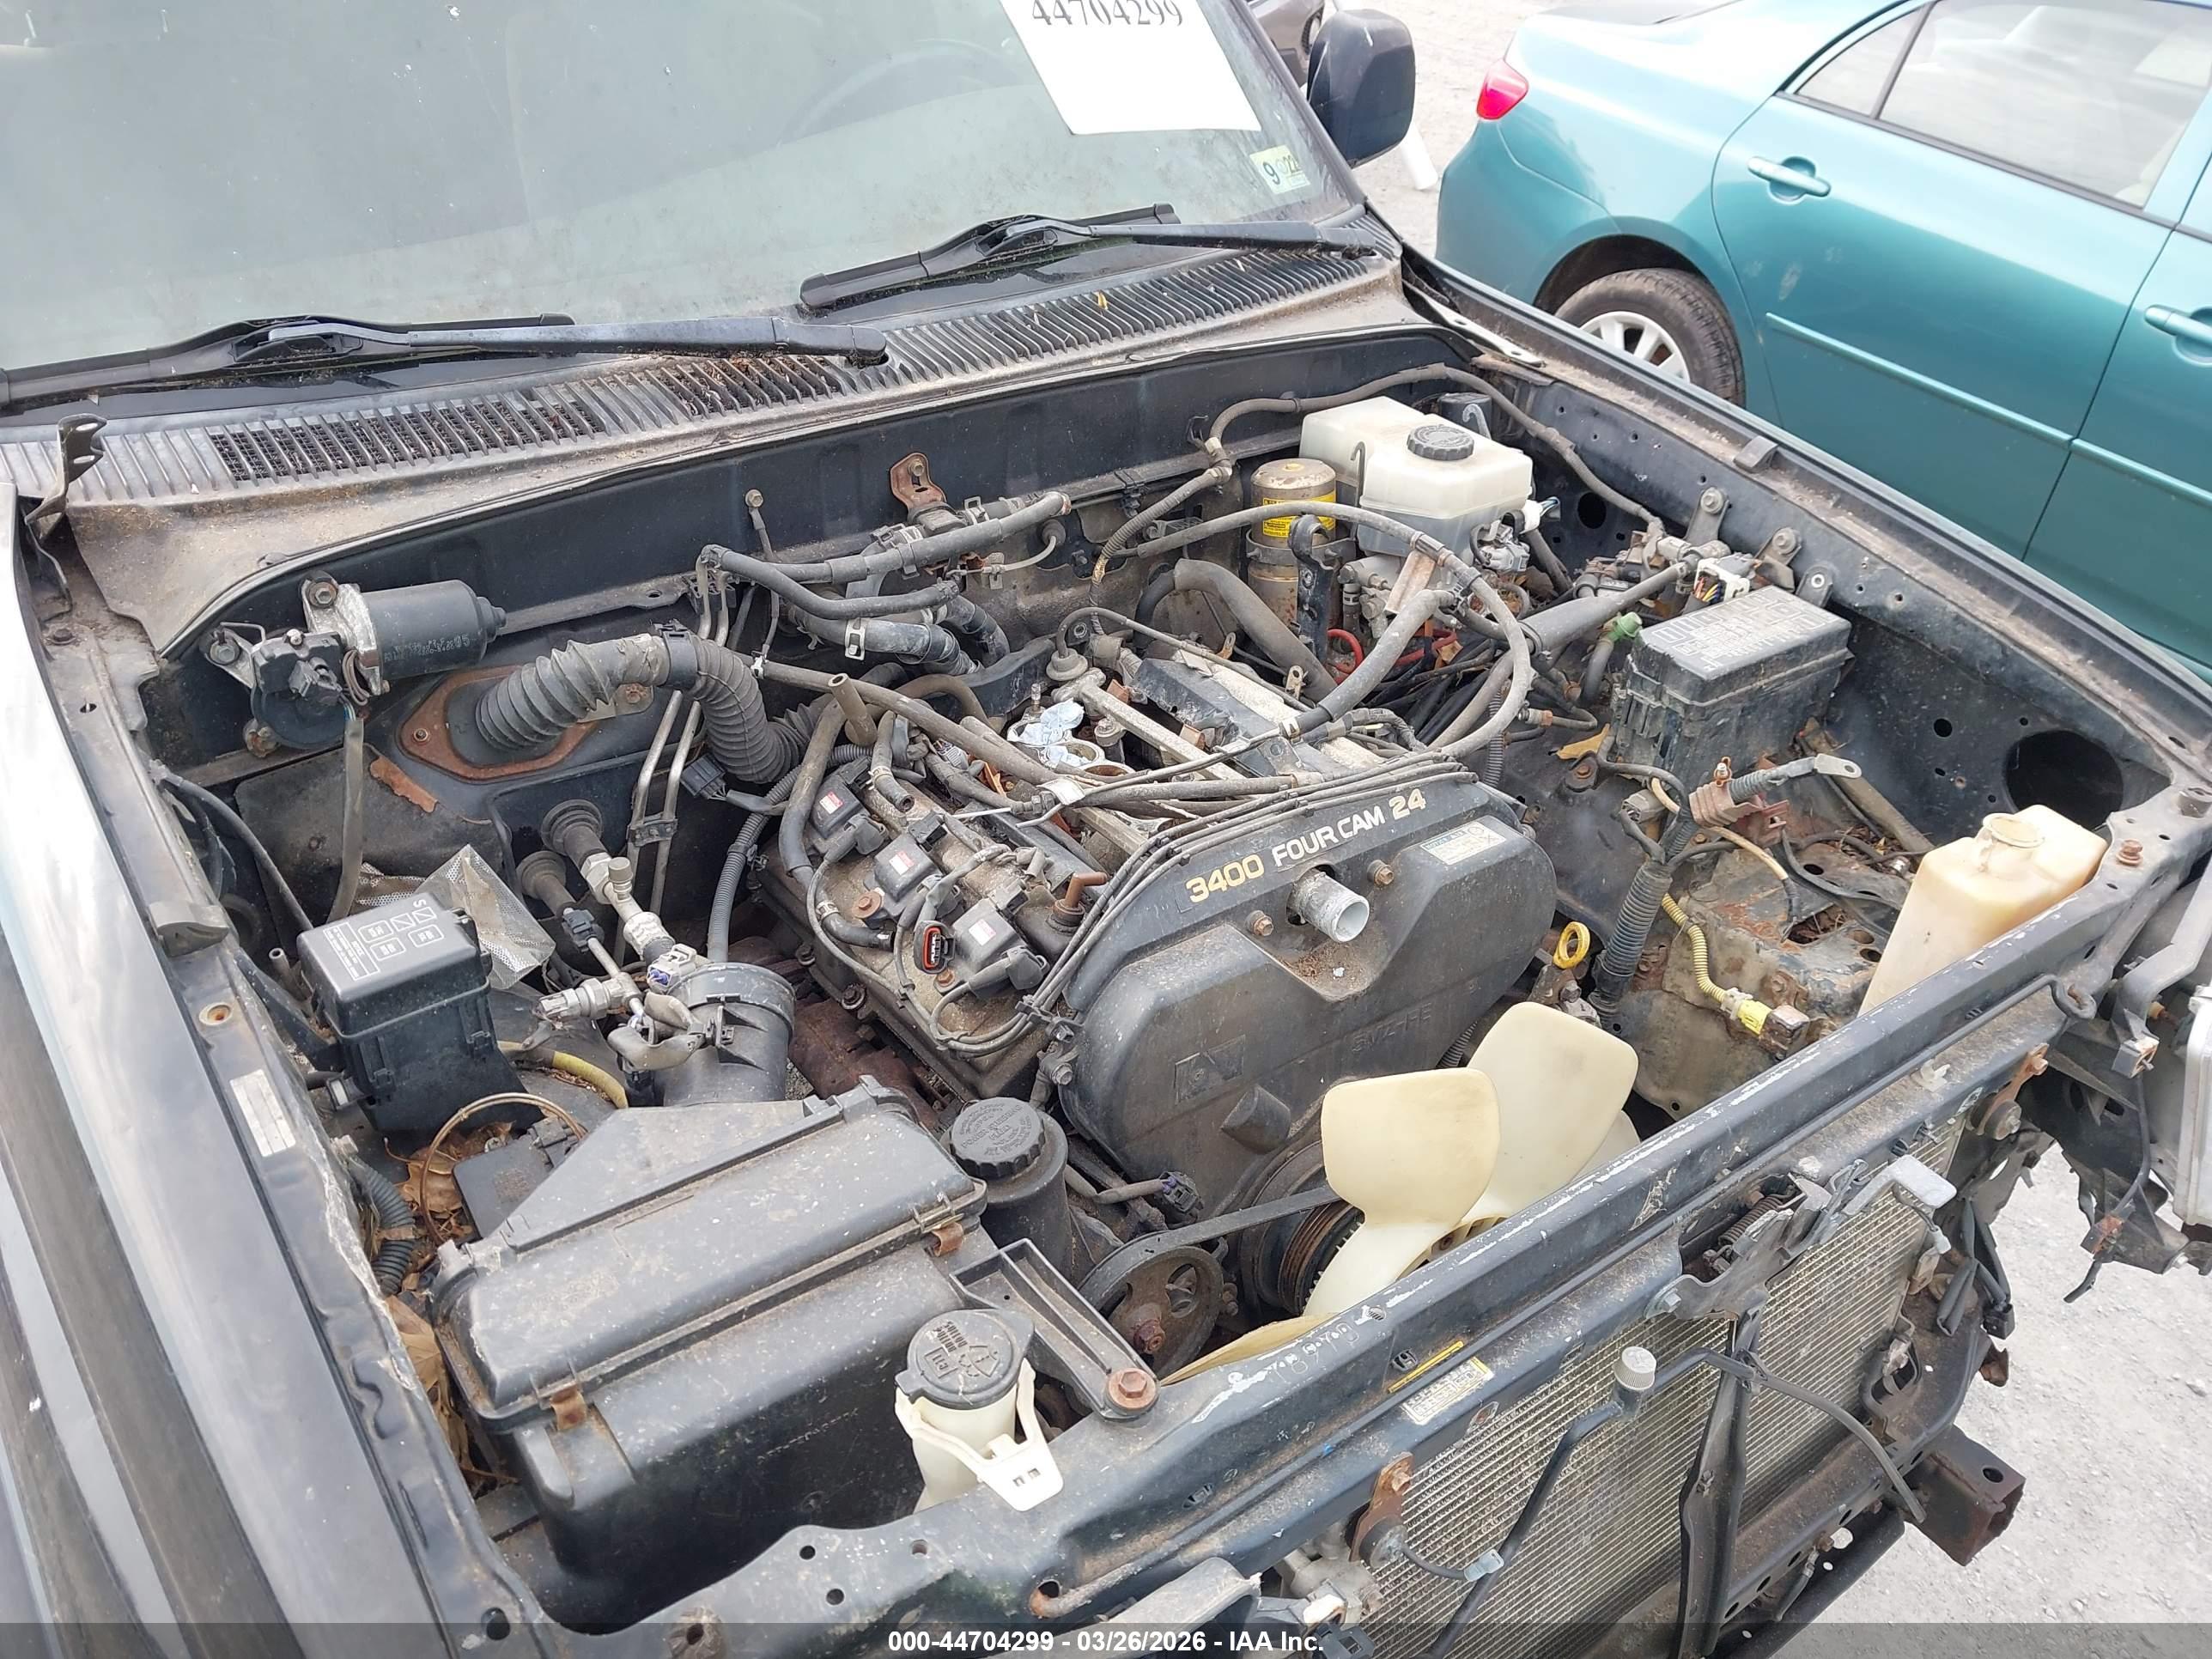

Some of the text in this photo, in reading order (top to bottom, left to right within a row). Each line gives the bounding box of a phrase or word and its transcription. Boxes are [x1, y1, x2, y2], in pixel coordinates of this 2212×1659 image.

[1032, 0, 1183, 26] 44704299
[1262, 161, 1281, 185] 9
[1185, 787, 1427, 903] 3400 FOUR CAM 24
[413, 899, 427, 908] S
